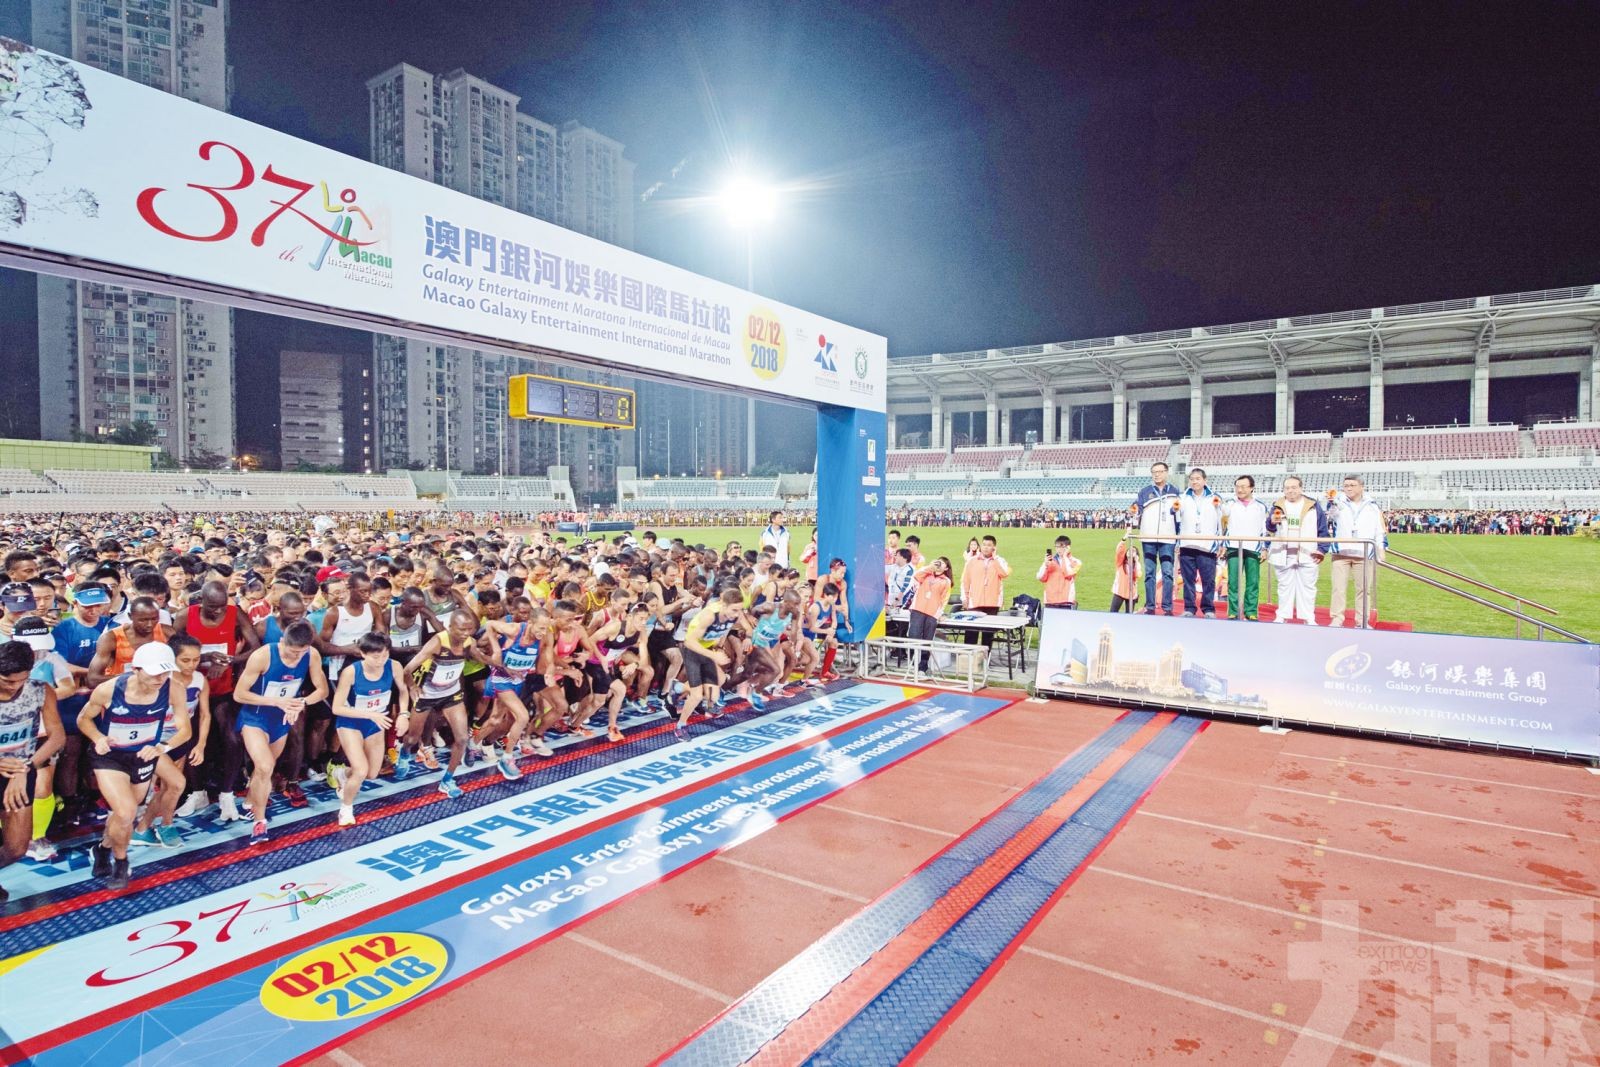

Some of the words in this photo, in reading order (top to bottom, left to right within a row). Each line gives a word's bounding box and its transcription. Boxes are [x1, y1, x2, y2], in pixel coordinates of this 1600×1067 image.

[136, 141, 315, 247] 37
[424, 215, 731, 335] 澳門銀河娛樂國際馬拉松
[422, 263, 474, 291] Galaxy
[478, 278, 569, 312] Entertainment
[572, 301, 626, 326] Maratona
[629, 315, 690, 342] Internacional
[691, 333, 702, 344] de
[704, 336, 731, 351] Macau
[423, 284, 476, 310] Macao
[480, 298, 528, 324] Galaxy
[531, 310, 618, 342] Entertainment
[622, 331, 687, 356] International
[689, 347, 731, 366] Marathon
[748, 315, 781, 346] 02/12
[751, 343, 778, 373] 2018
[280, 687, 287, 697] 5
[367, 700, 381, 708] 54
[445, 671, 455, 680] 13
[1385, 659, 1547, 691] 銀河娛樂集團
[1385, 680, 1421, 694] Galaxy
[1425, 684, 1505, 701] Entertainment
[1508, 691, 1548, 706] Group
[129, 730, 139, 740] 3
[460, 865, 573, 915] Galaxy
[572, 794, 737, 867] Entertainment
[733, 760, 819, 798] Maratona
[814, 725, 893, 765] Internacional
[893, 716, 913, 729] de
[490, 875, 608, 931] Macao
[606, 831, 702, 875] Galaxy
[85, 898, 252, 987] 37
[272, 935, 412, 998] 02/12
[314, 955, 437, 1017] 2018
